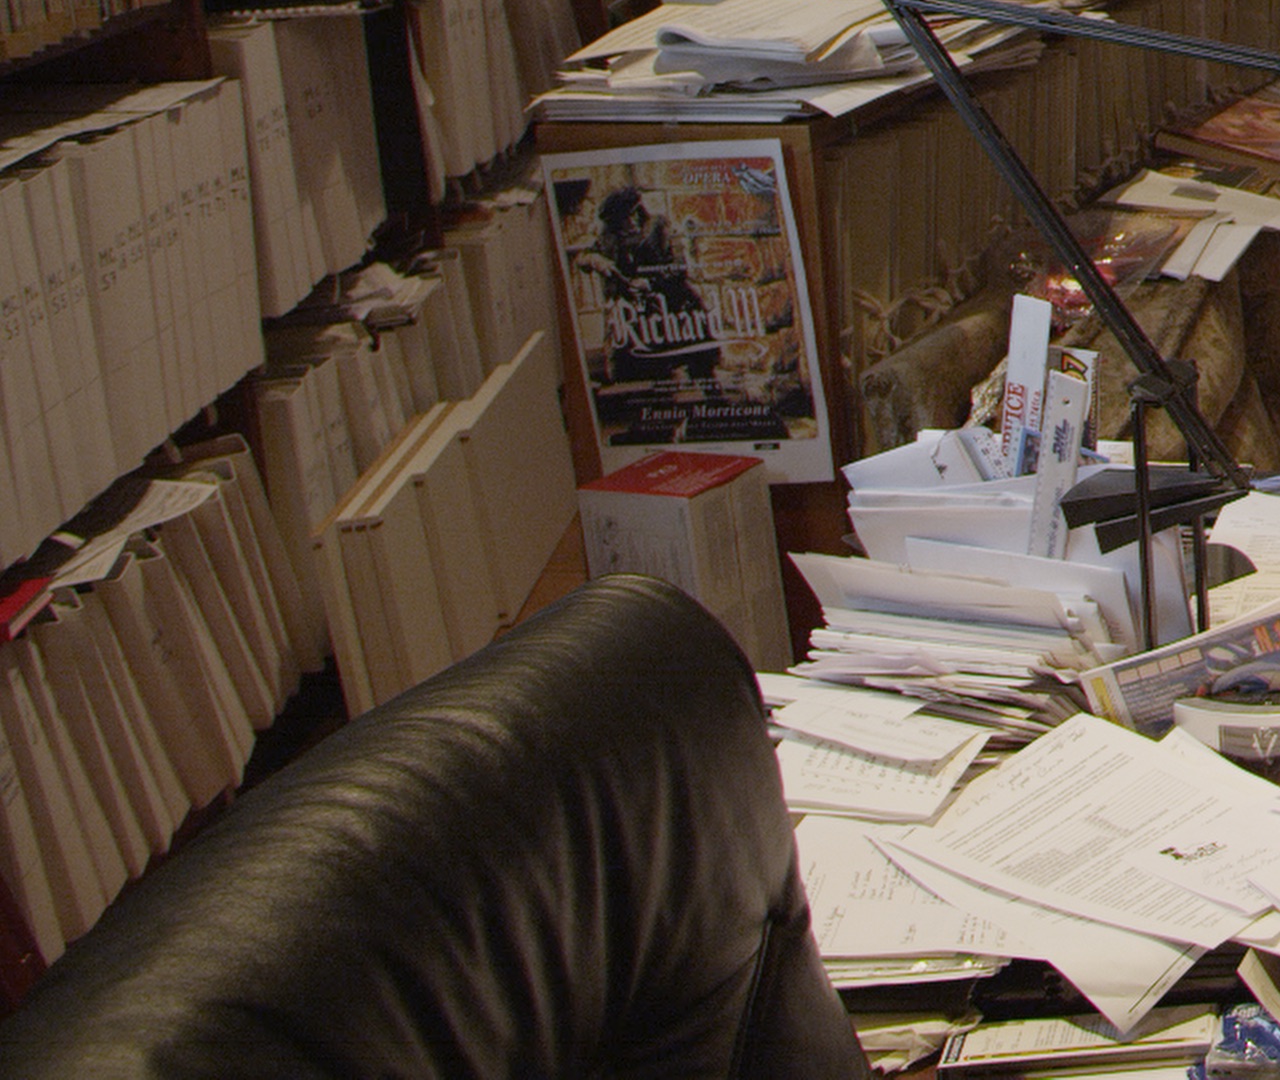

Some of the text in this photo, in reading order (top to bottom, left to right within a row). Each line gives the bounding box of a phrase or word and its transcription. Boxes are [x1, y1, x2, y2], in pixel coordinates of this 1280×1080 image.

[682, 172, 731, 184] OPERA
[607, 289, 723, 348] Richard
[641, 404, 771, 421] Ennio Morricone
[1052, 419, 1068, 462] DHL
